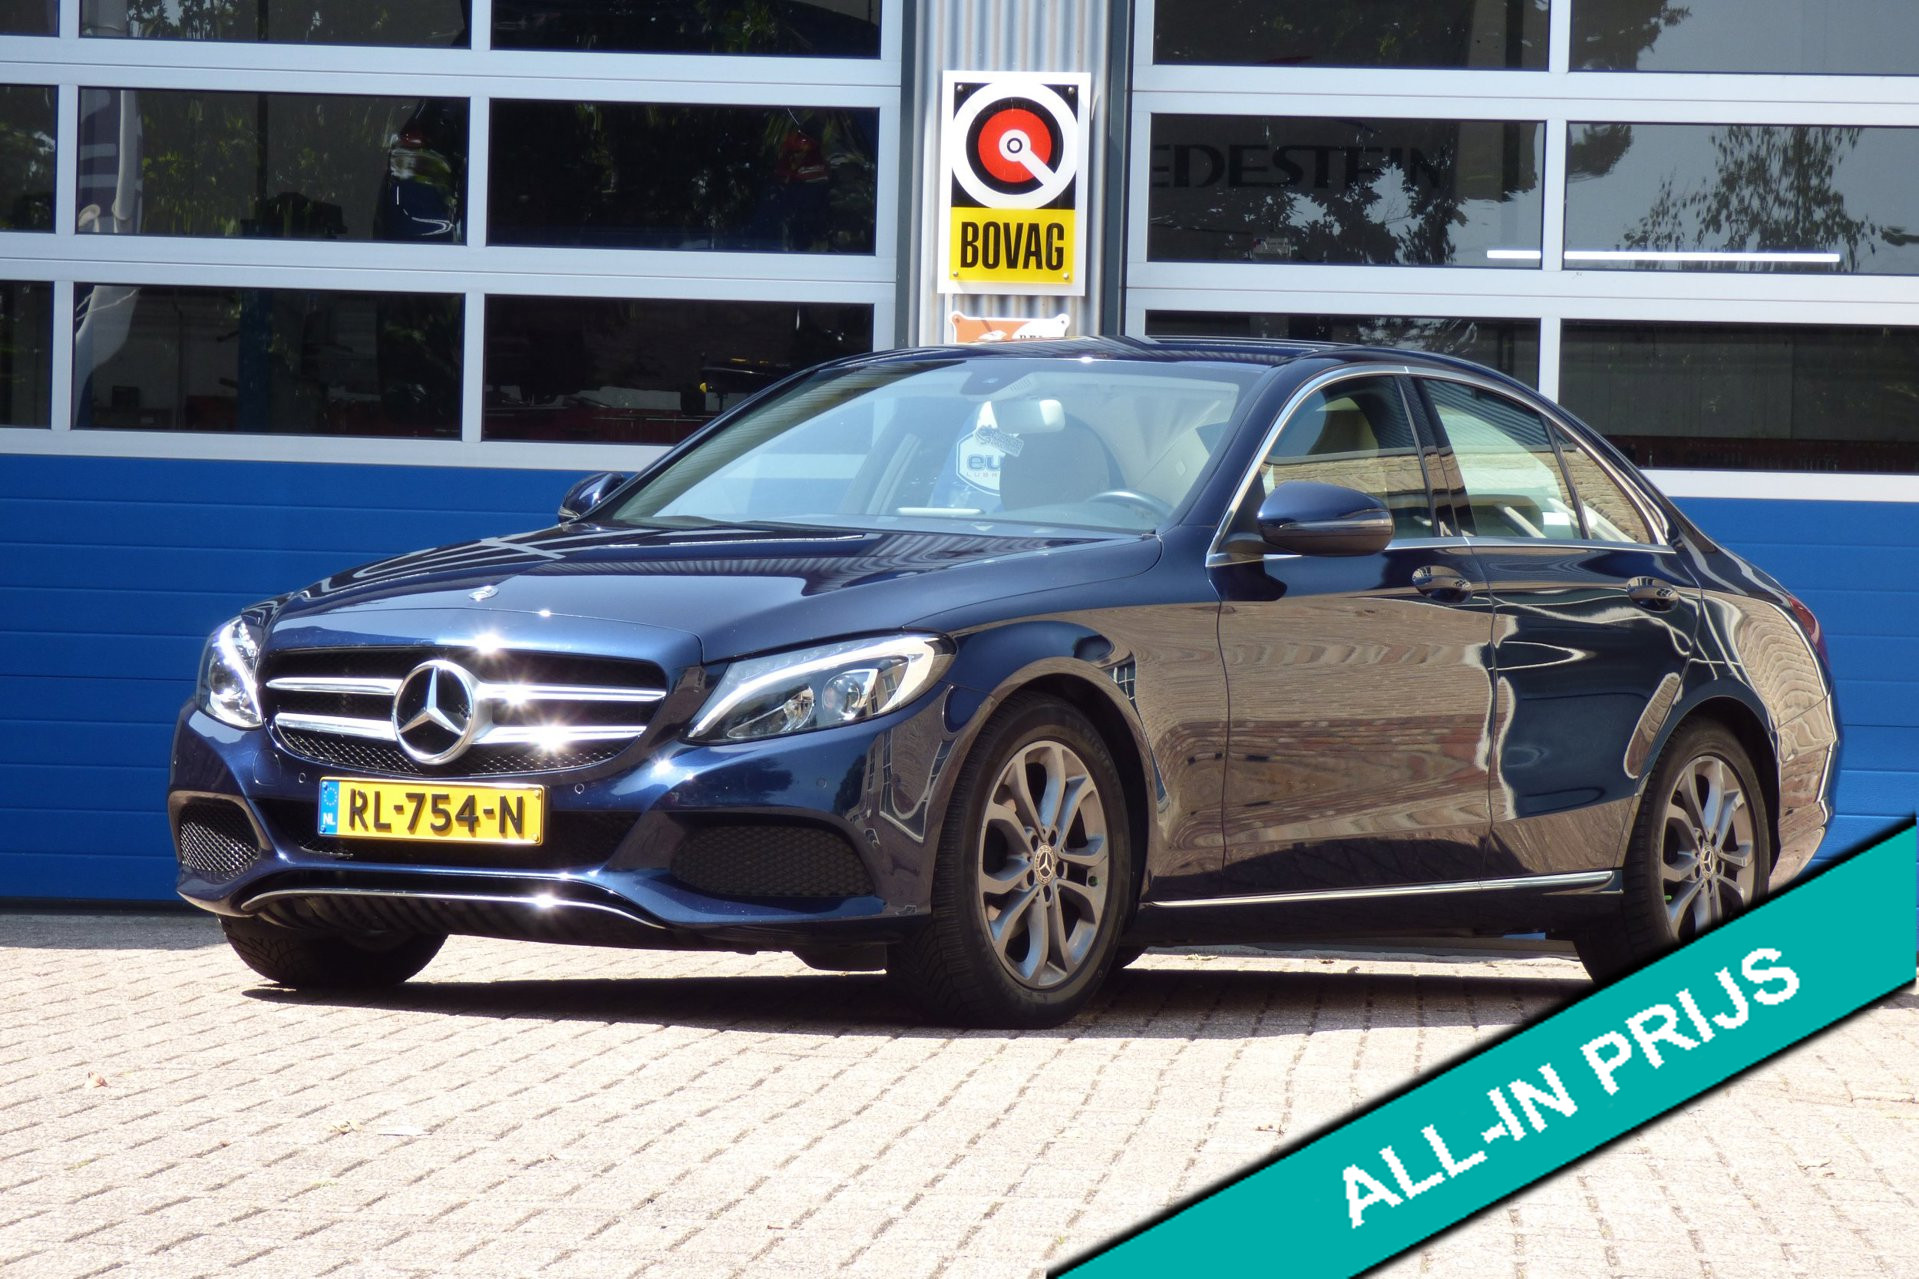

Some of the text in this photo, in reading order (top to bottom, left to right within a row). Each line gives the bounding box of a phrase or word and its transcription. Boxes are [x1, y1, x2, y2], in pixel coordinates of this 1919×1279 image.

[960, 221, 1065, 271] BOVAG
[322, 788, 525, 836] NL RL-754-N
